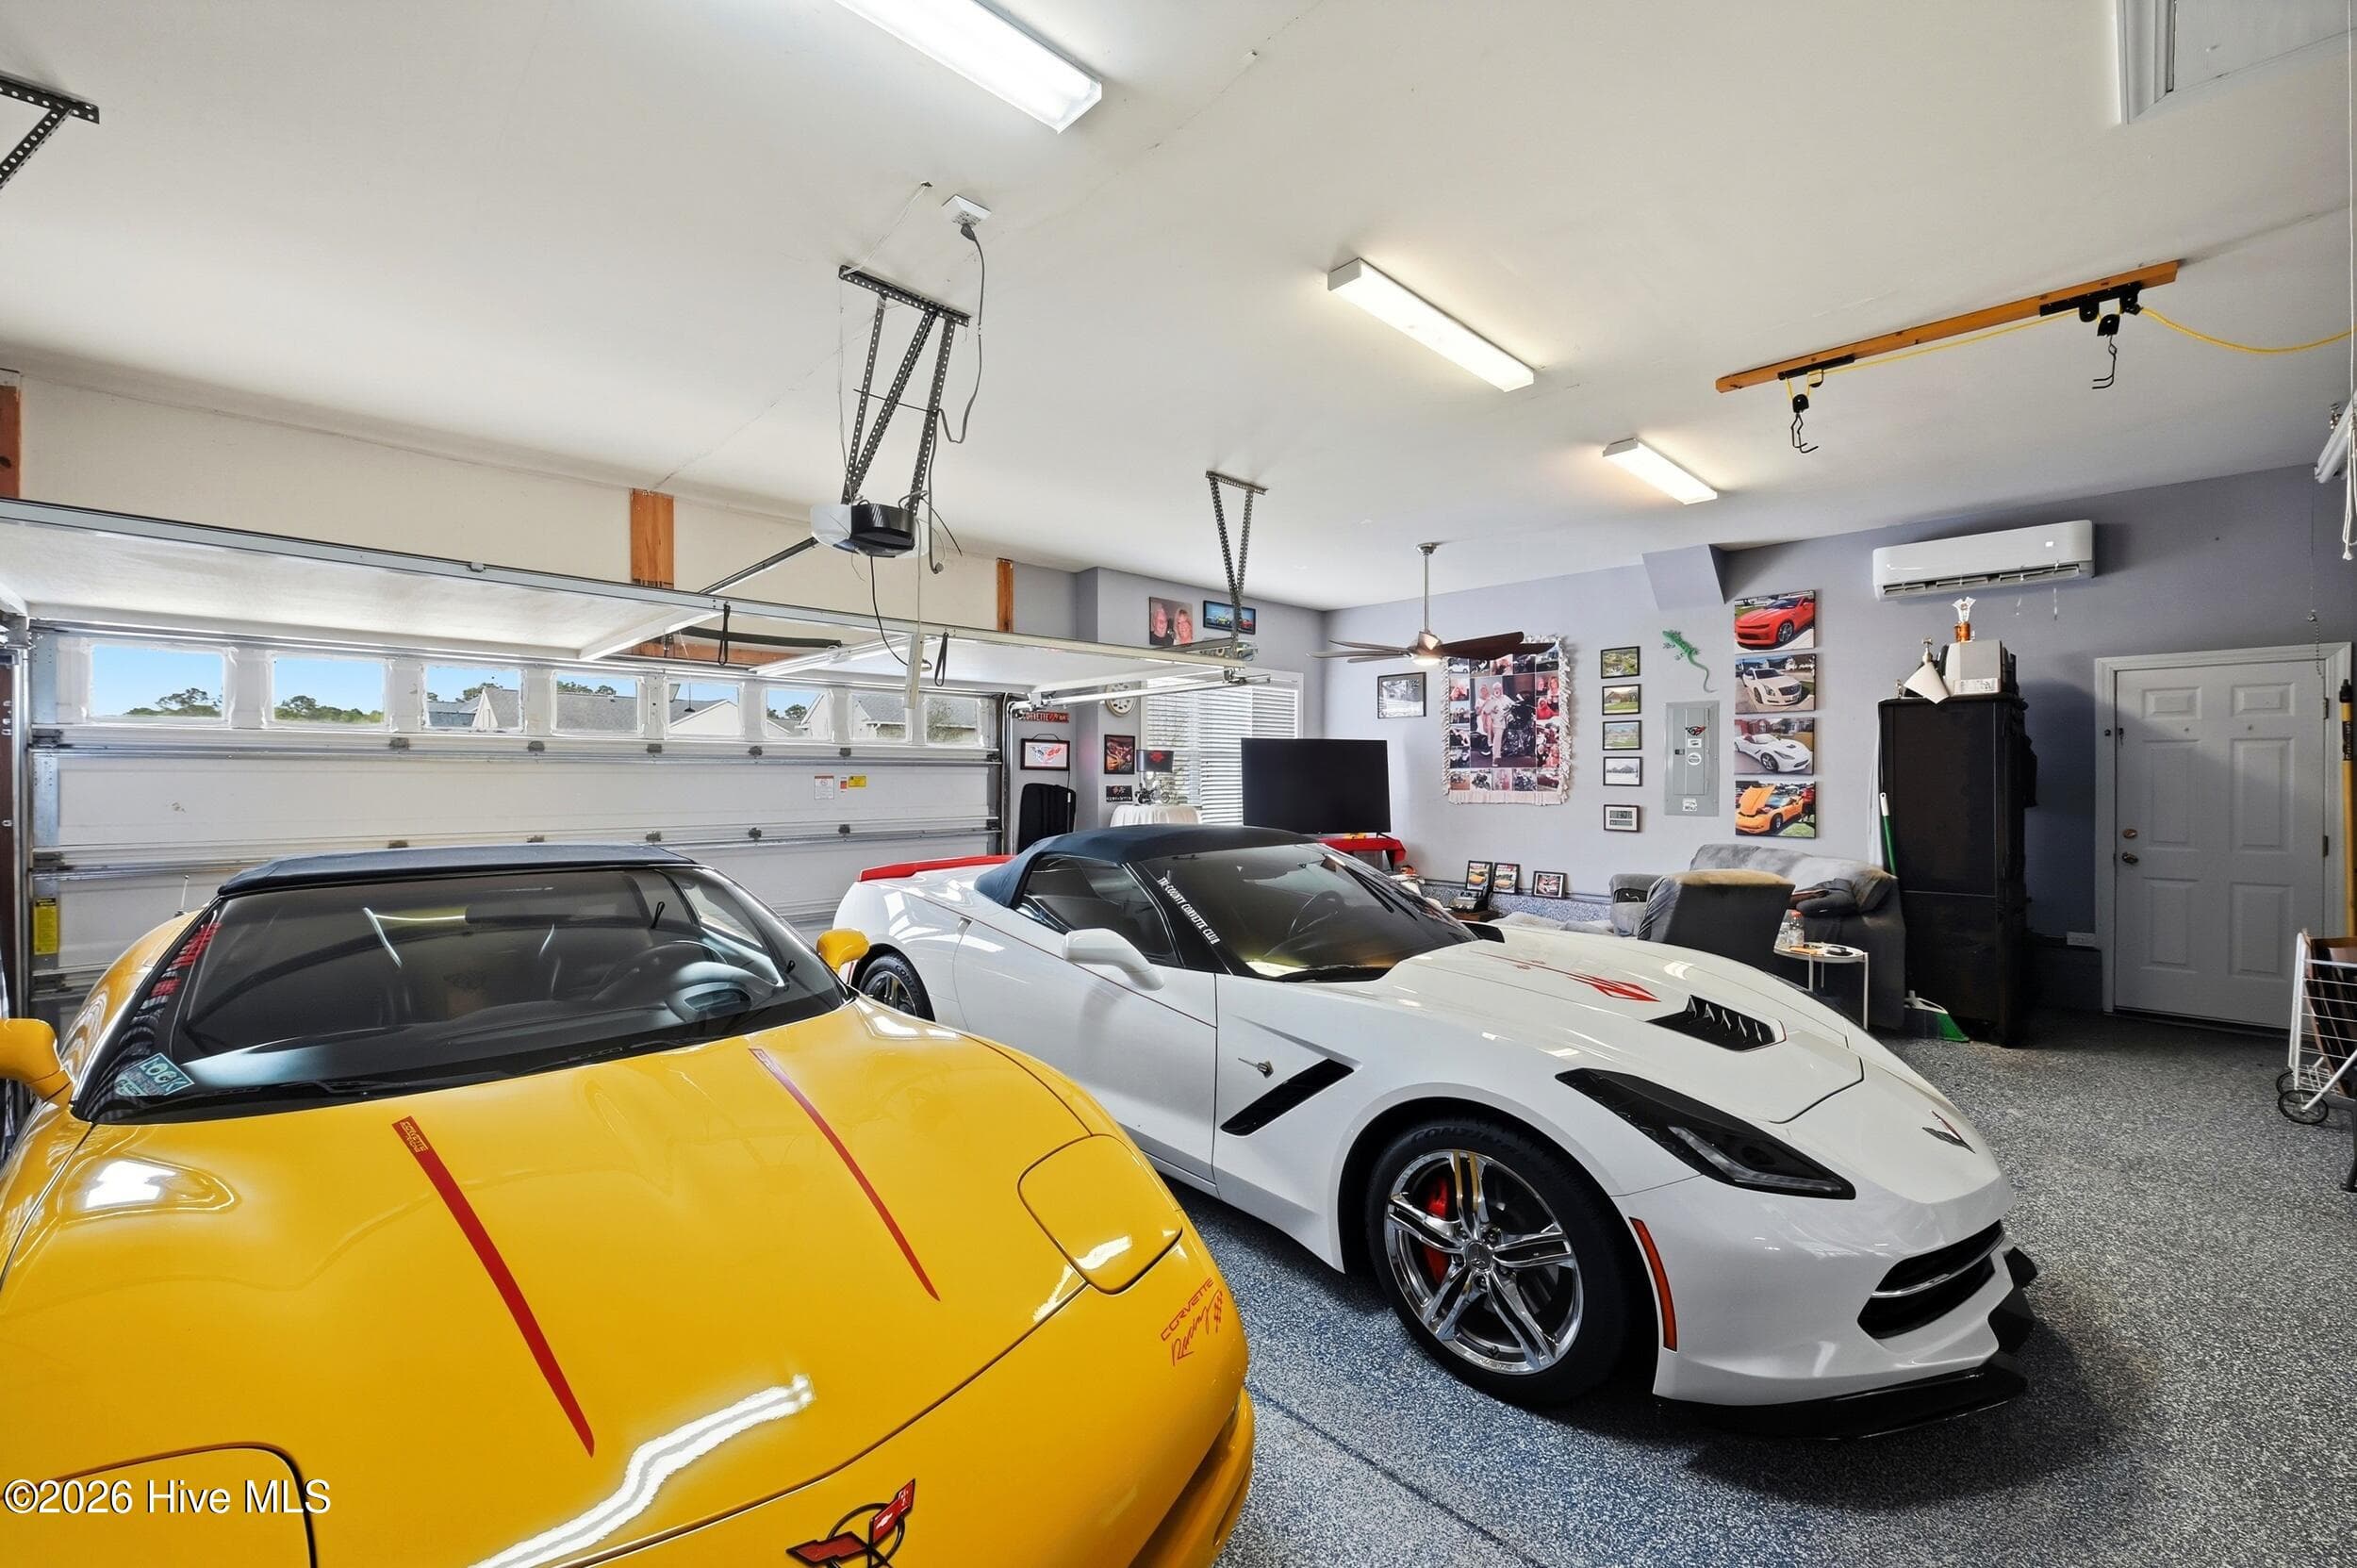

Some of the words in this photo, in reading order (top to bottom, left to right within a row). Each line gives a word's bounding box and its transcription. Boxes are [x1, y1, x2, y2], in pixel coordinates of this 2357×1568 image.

[1202, 928, 1221, 945] CLUB
[139, 1055, 188, 1092] LOOK
[1161, 1277, 1214, 1342] CORVETTE
[1171, 1289, 1220, 1366] Racing
